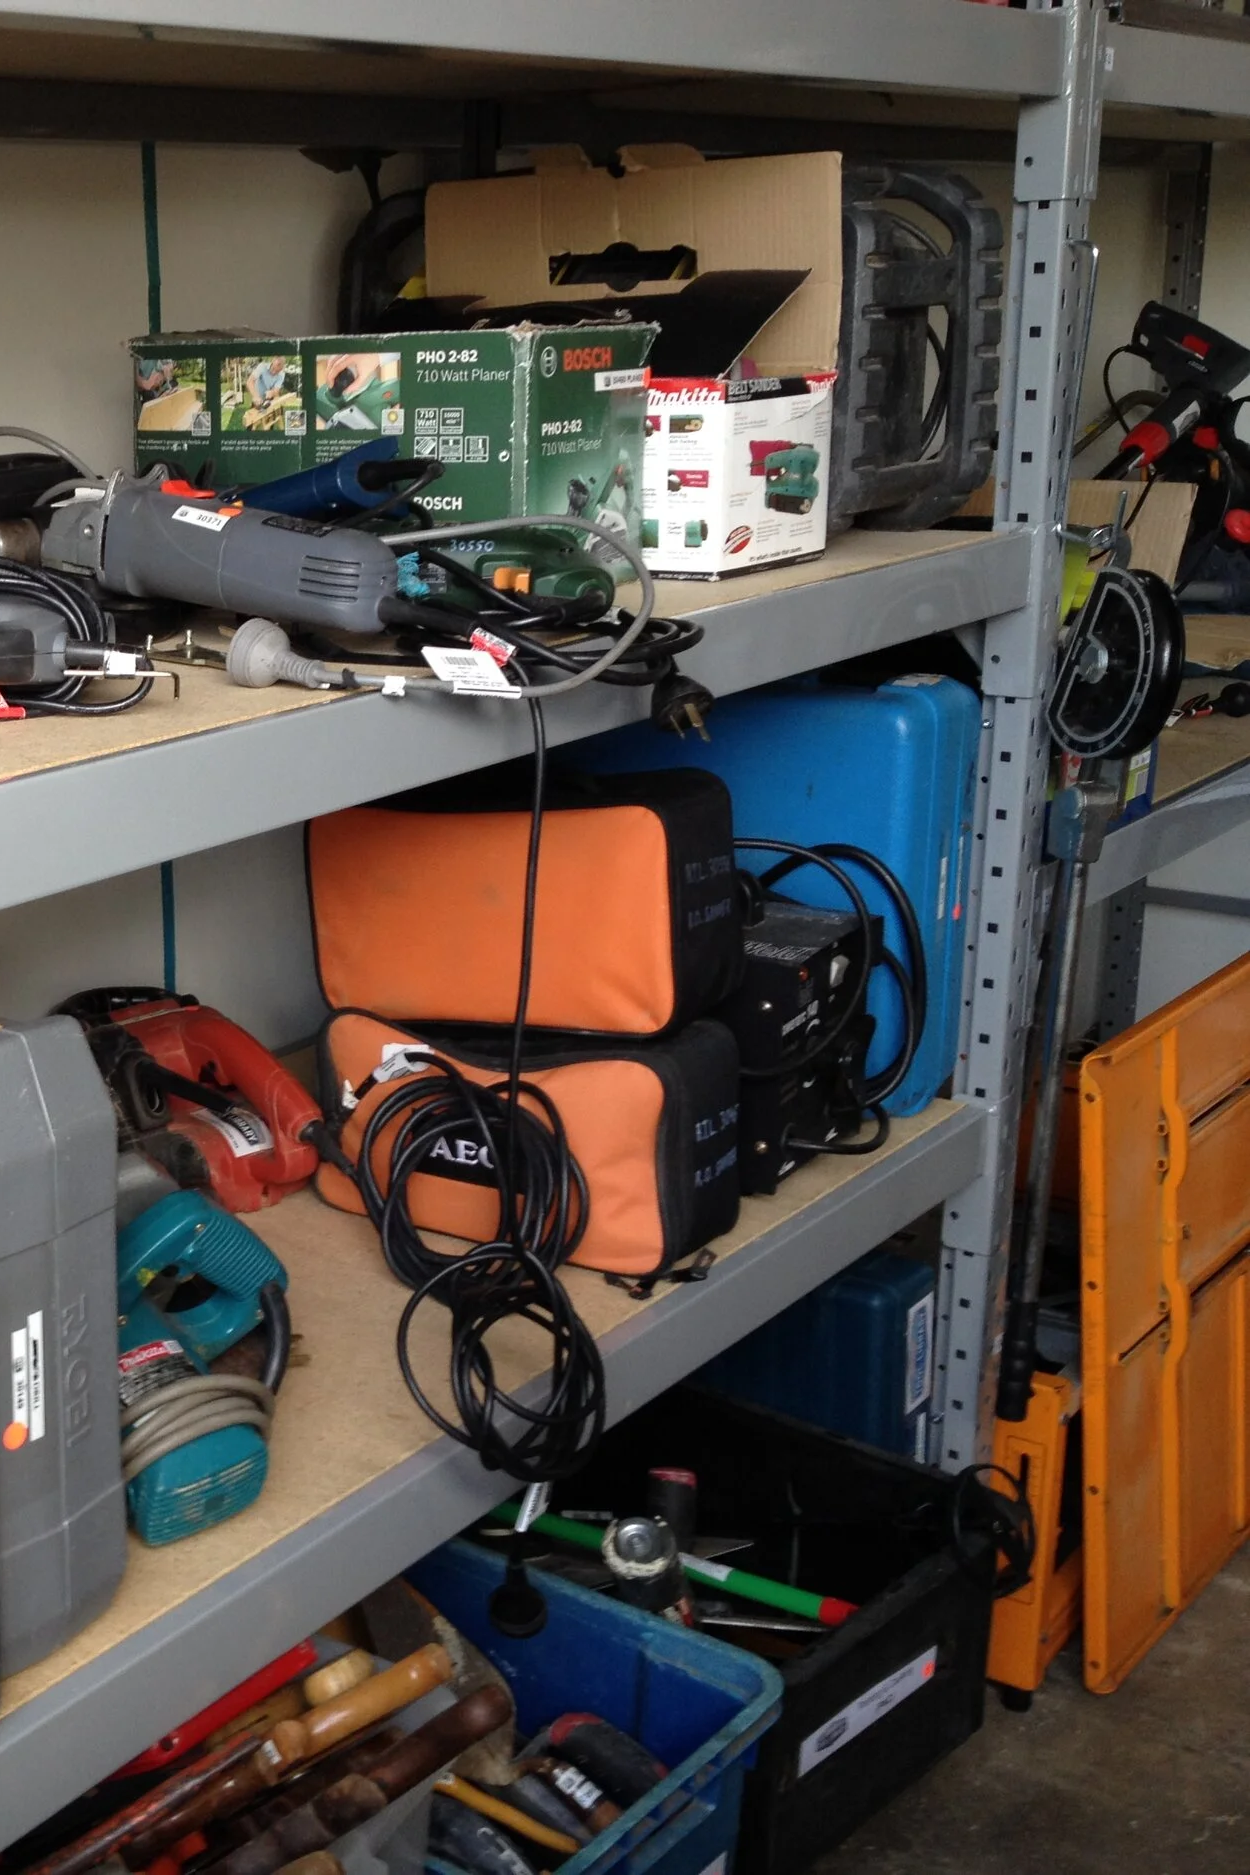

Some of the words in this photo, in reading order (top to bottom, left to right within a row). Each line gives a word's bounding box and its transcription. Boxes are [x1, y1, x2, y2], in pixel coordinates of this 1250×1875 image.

[416, 351, 444, 364] PHO
[563, 347, 612, 372] BOSCH
[416, 370, 439, 382] 710
[440, 370, 468, 381] Watt
[471, 369, 511, 381] Planer
[728, 381, 748, 394] BELT
[750, 378, 782, 392] SANDER
[541, 422, 562, 436] PHO
[541, 442, 557, 455] 710
[557, 441, 576, 454] Watt
[577, 438, 602, 452] Planer
[62, 1293, 92, 1448] RYOBI
